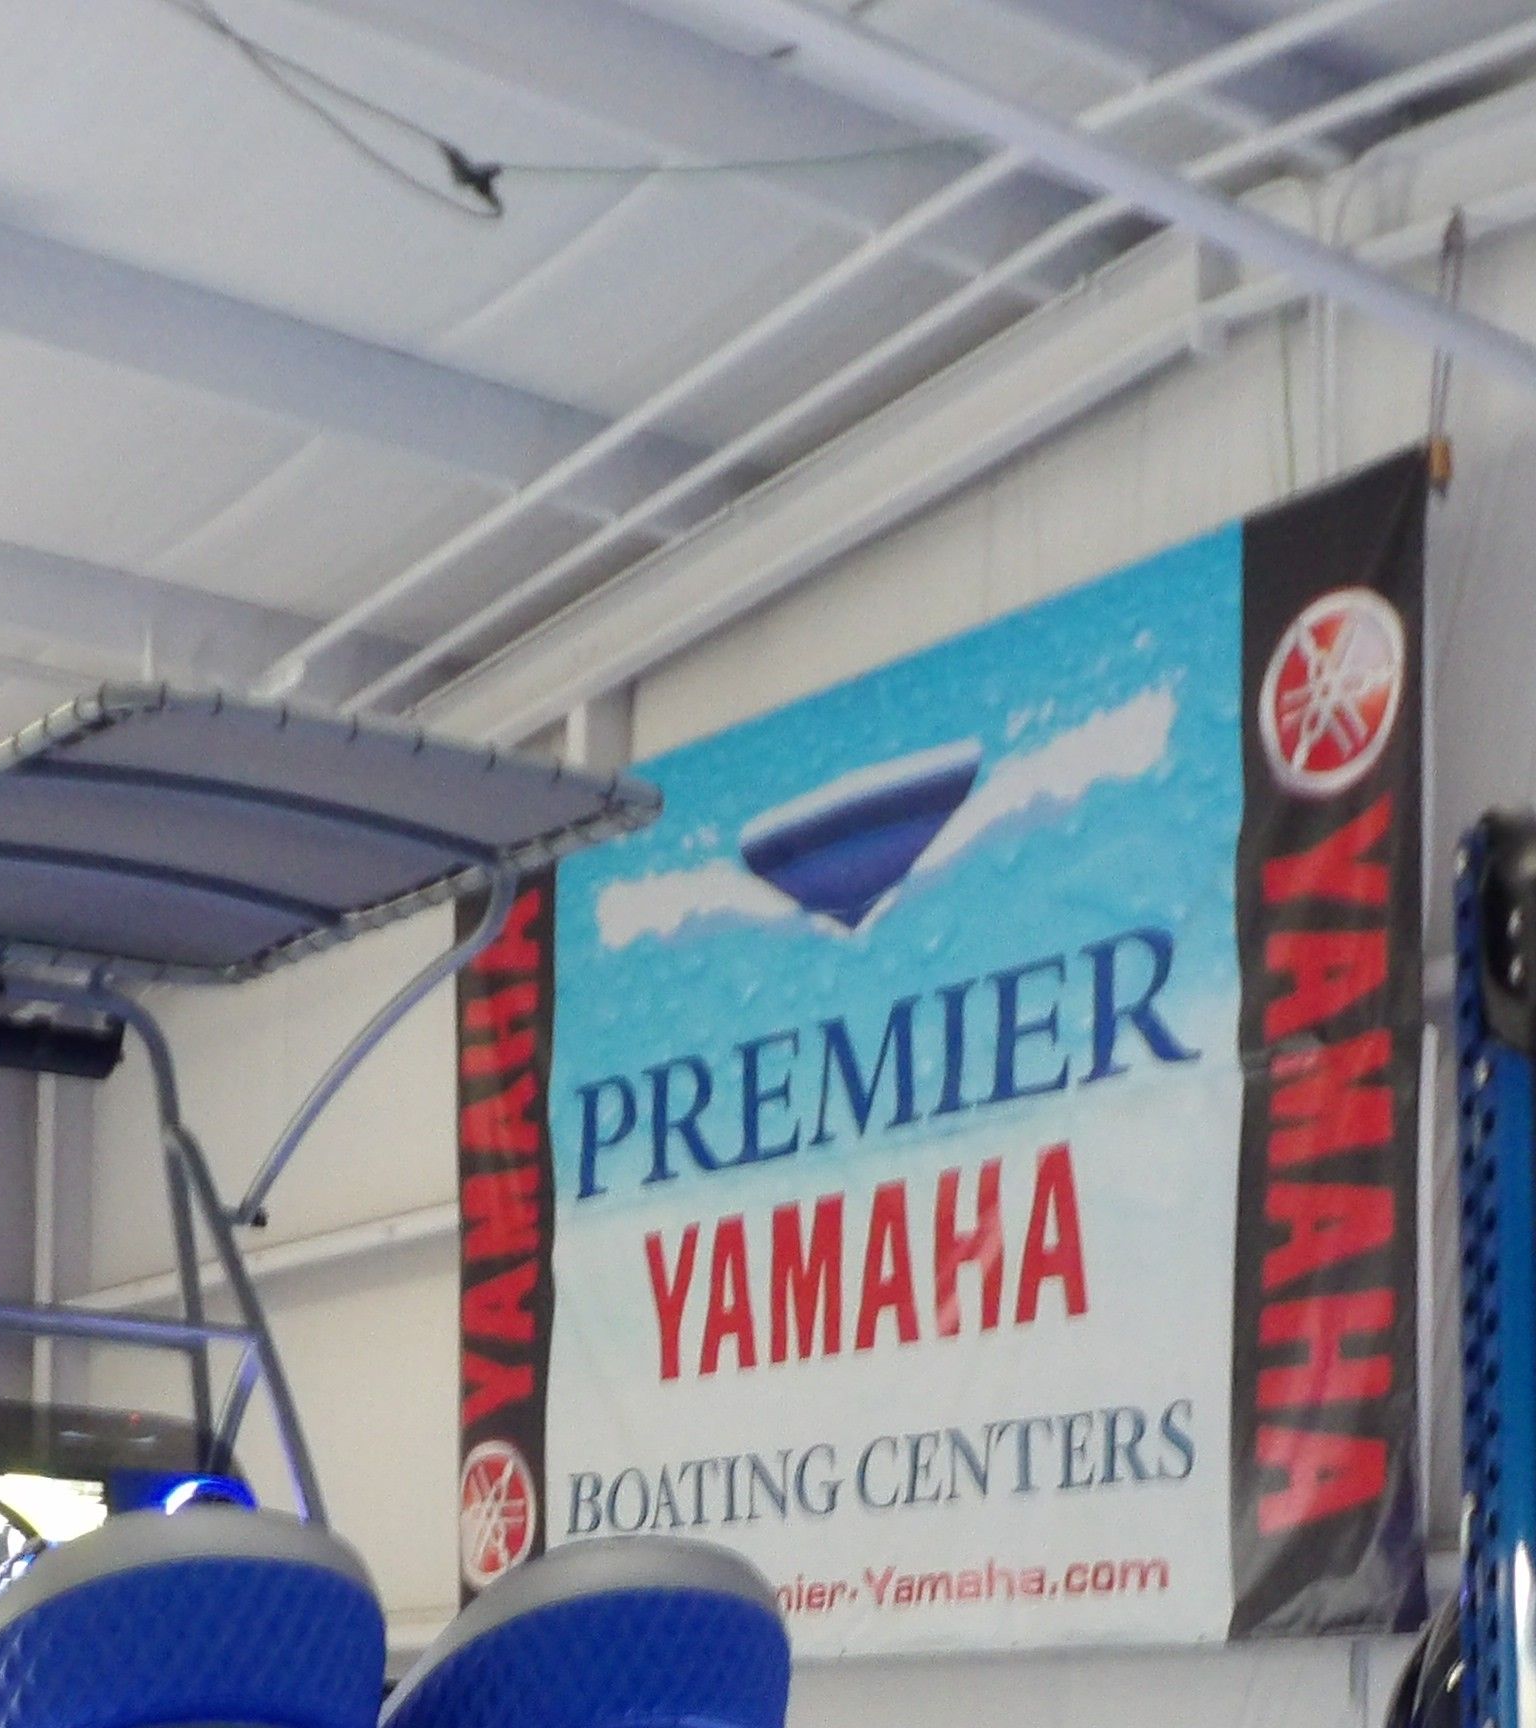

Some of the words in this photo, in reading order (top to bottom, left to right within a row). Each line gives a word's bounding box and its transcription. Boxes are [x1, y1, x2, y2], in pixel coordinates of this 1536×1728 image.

[459, 886, 543, 1430] YAMAHA
[574, 926, 1201, 1201] PREMIER
[1254, 791, 1396, 1537] YAMAHA
[645, 1139, 1089, 1381] YAMAHA
[566, 1442, 846, 1535] BOATING
[854, 1398, 1197, 1511] CENTERS
